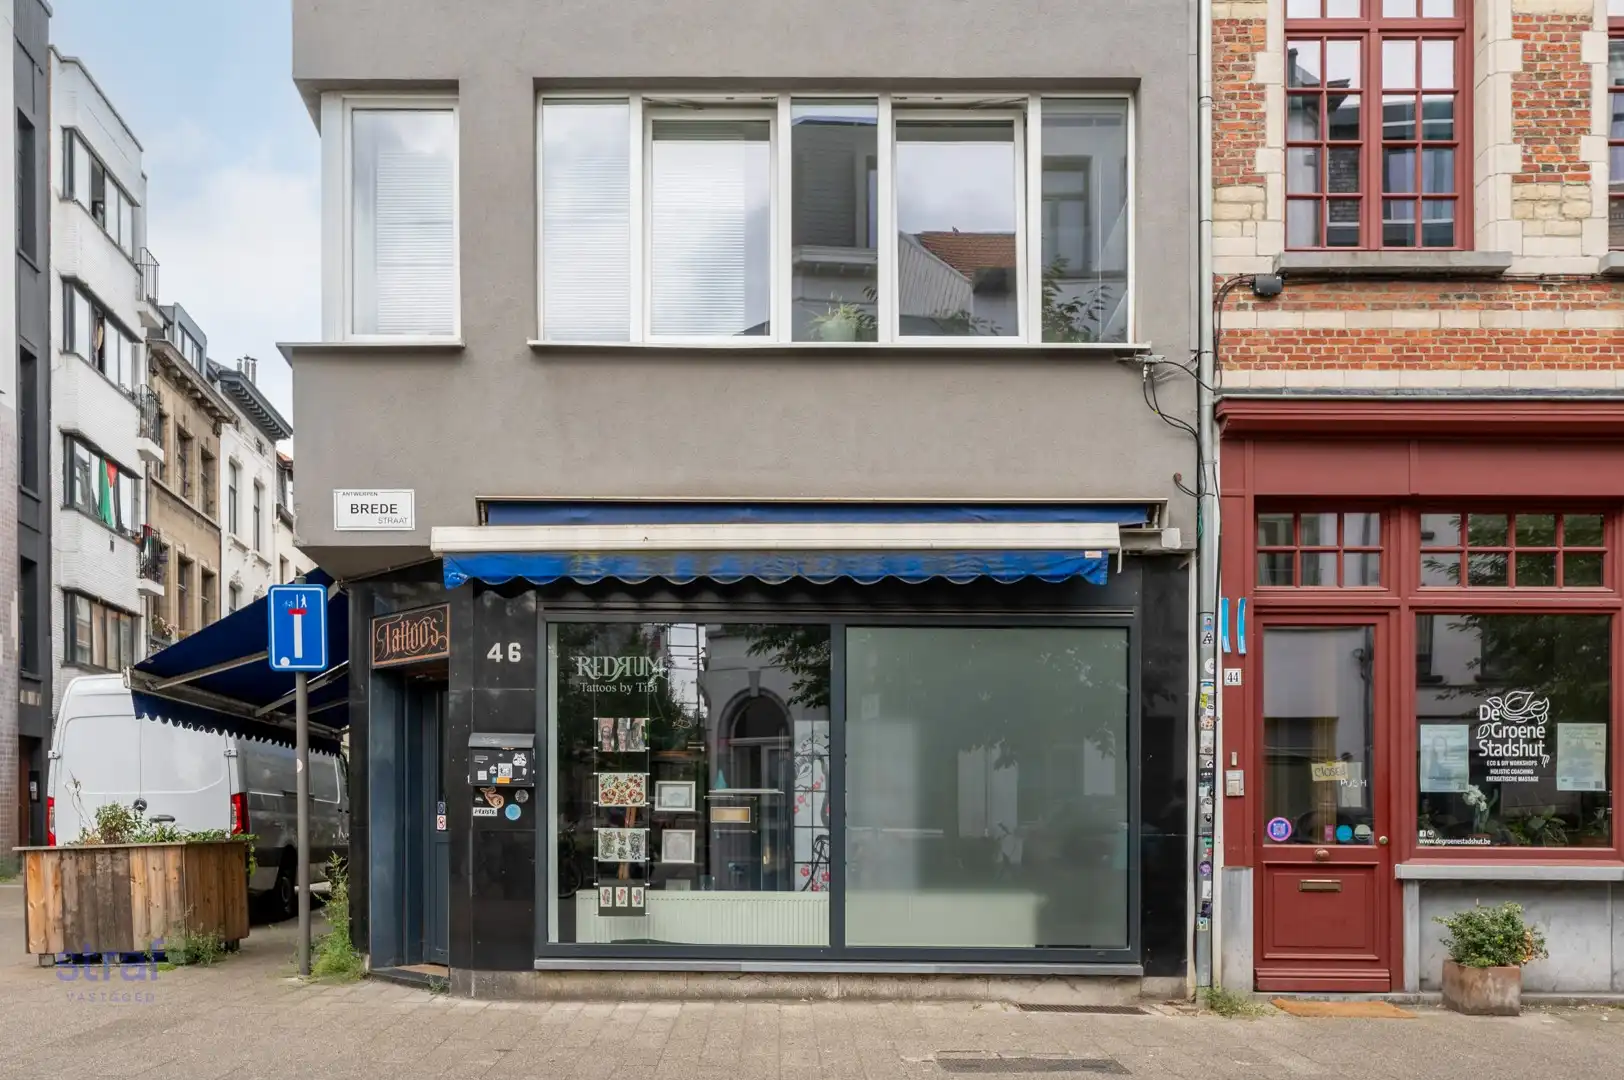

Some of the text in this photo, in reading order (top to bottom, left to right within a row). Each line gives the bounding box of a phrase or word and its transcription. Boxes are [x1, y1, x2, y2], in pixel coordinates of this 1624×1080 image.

[350, 503, 398, 514] BREDE
[377, 516, 409, 525] STRAAT
[486, 642, 522, 663] 46
[1227, 671, 1239, 683] 44
[580, 682, 617, 693] Tattoos
[620, 682, 633, 695] by
[1480, 704, 1501, 721] De
[1491, 722, 1546, 739] Groene
[1479, 738, 1546, 757] Stadshut
[1340, 779, 1367, 788] PUSH
[1419, 838, 1491, 846] www.degroenestadshut.be
